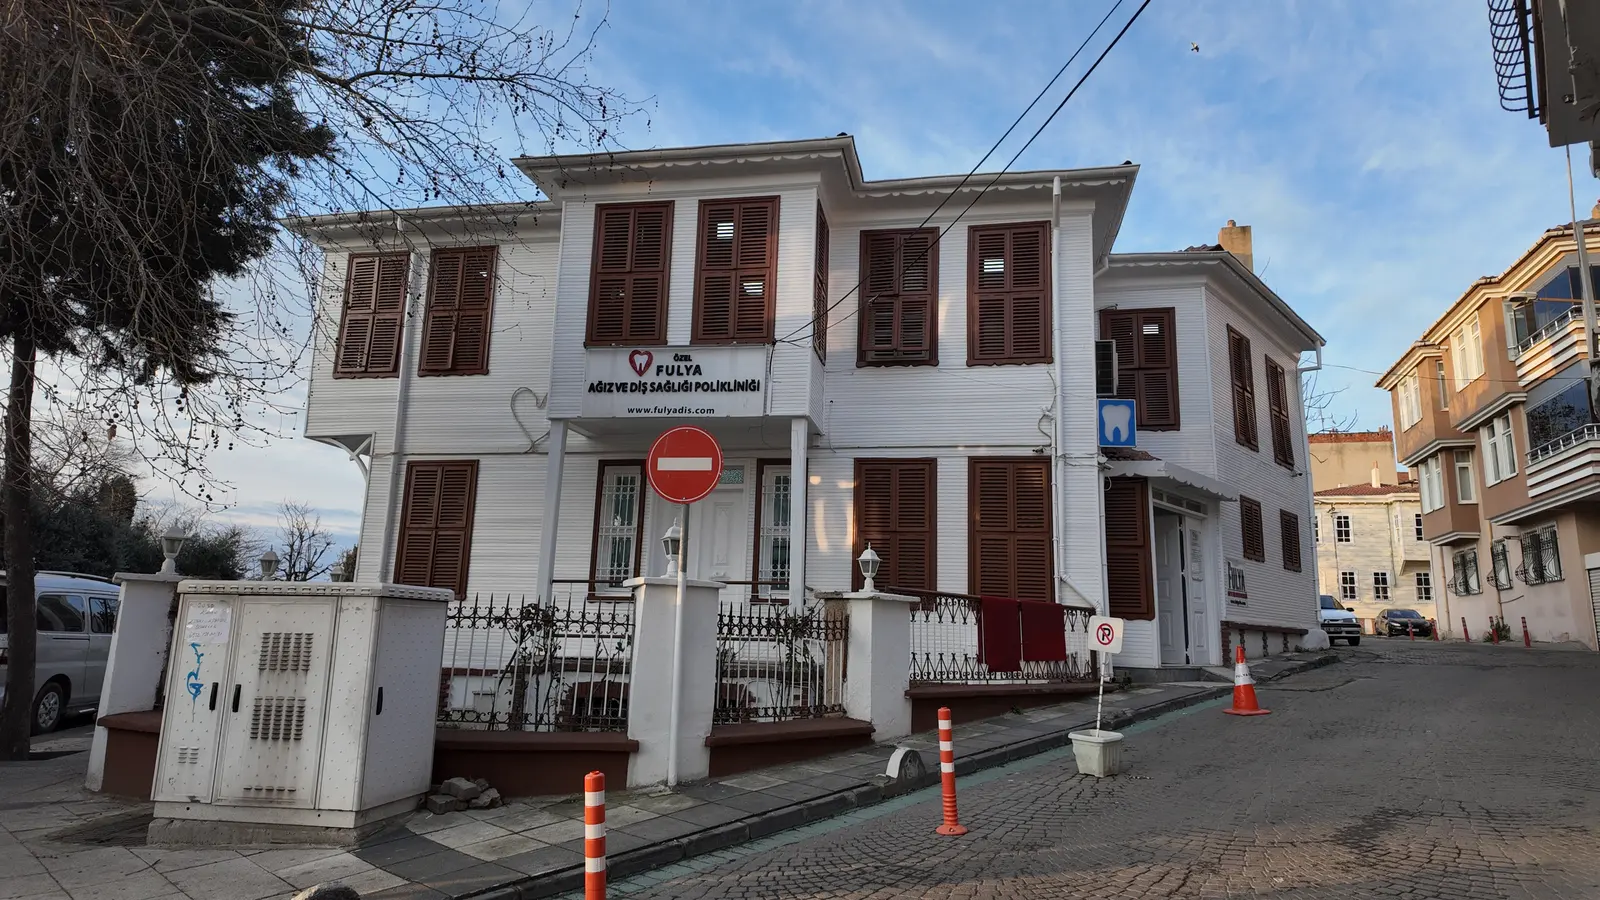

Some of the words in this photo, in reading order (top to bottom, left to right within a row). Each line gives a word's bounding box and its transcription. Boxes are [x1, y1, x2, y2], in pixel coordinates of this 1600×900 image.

[673, 353, 693, 362] ÖZEL
[656, 365, 703, 376] FULYA
[588, 380, 615, 393] AĞIZ
[615, 382, 629, 393] VE
[629, 380, 648, 395] DİŞ
[649, 380, 693, 393] SAĞLIĞI
[694, 379, 760, 393] POLİKLİNİĞİ
[627, 405, 715, 415] www.fulyadis.com
